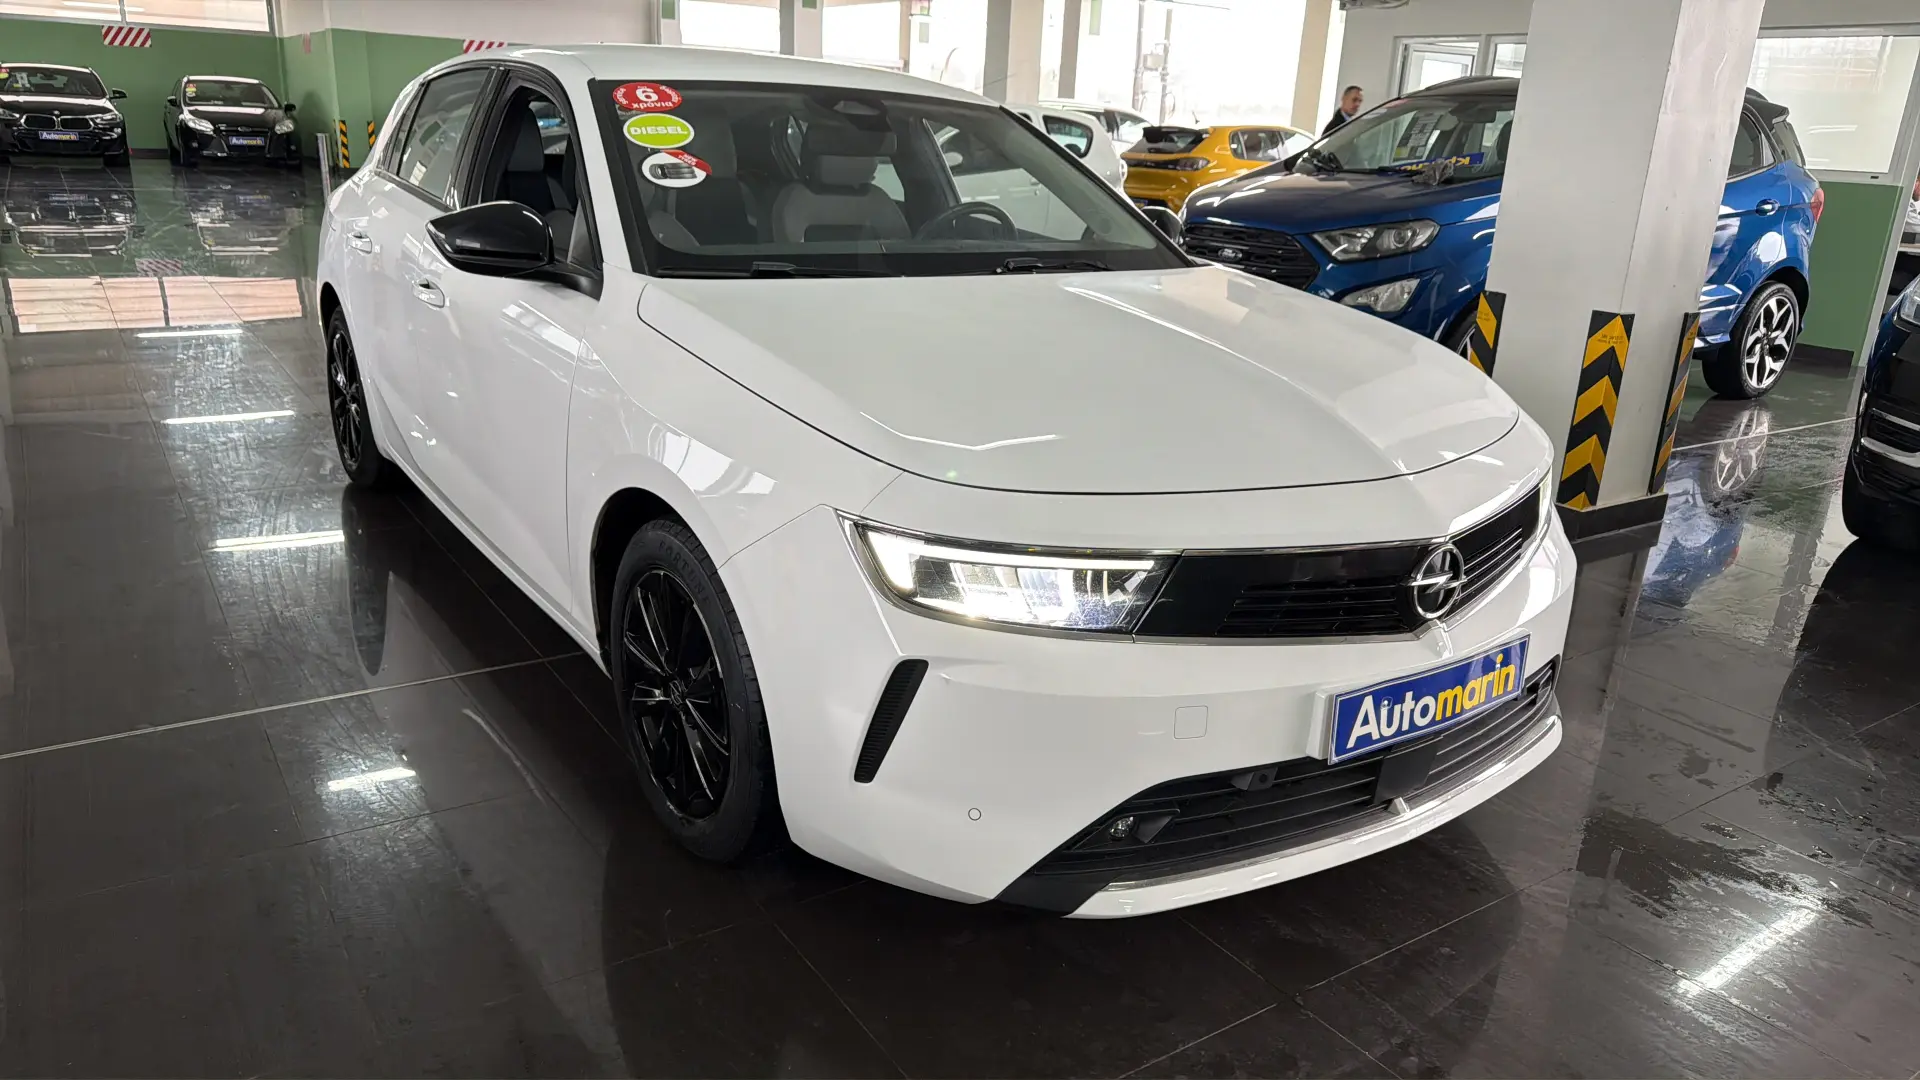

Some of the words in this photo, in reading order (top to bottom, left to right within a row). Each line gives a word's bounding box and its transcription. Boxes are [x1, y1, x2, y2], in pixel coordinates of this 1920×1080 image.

[636, 88, 659, 102] 6
[632, 100, 673, 109] χρόνια
[630, 126, 688, 135] DIESEL
[1346, 653, 1516, 749] Automarin
